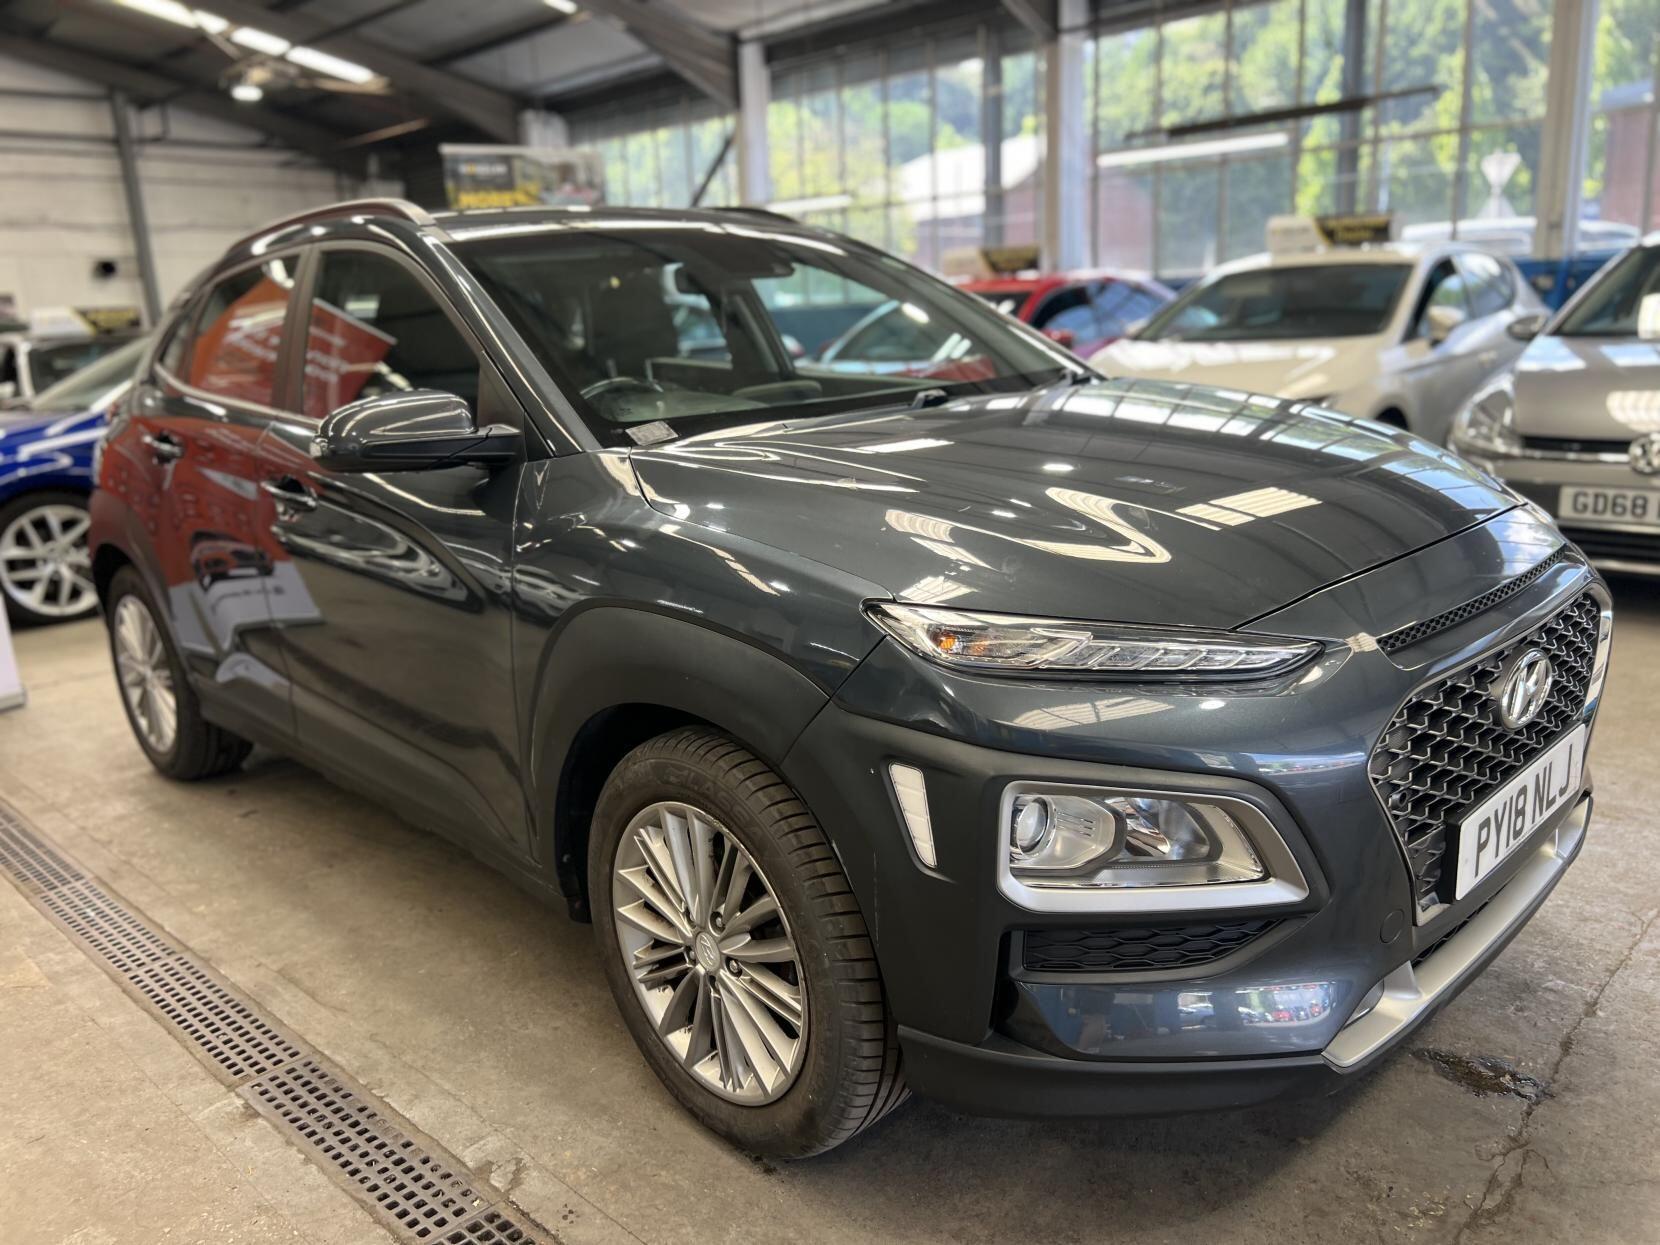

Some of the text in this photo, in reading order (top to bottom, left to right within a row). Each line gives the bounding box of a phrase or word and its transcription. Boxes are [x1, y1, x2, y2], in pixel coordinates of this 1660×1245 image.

[1573, 491, 1649, 518] GD68
[1475, 744, 1573, 878] PY18 NLJ
